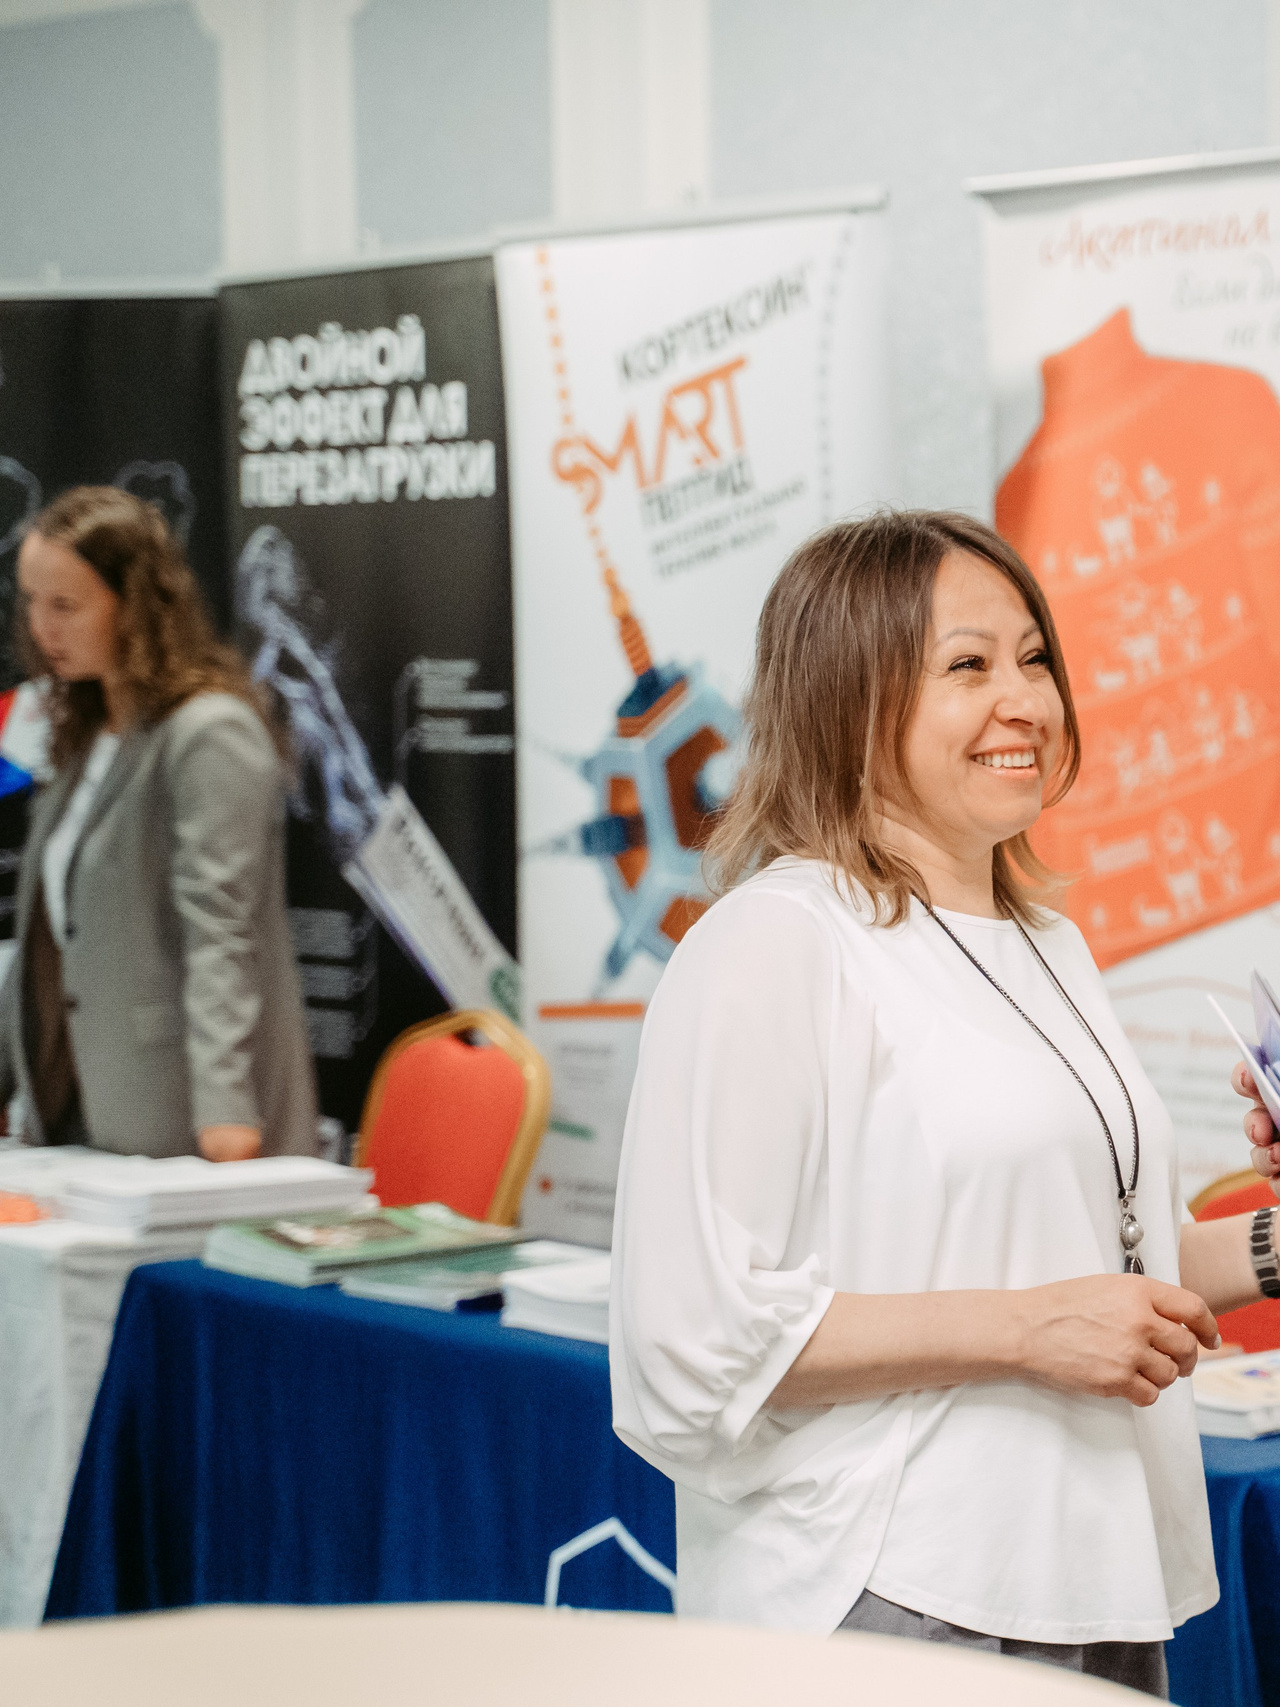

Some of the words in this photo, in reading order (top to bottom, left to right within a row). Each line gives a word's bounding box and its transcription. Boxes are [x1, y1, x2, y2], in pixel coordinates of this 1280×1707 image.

[238, 314, 427, 396] ДВОЙНОЙ
[239, 386, 387, 451] ЭФФЕКТ
[387, 381, 469, 444] ДЛЯ
[240, 440, 497, 508] ПЕРЕЗАГРУЗКИ
